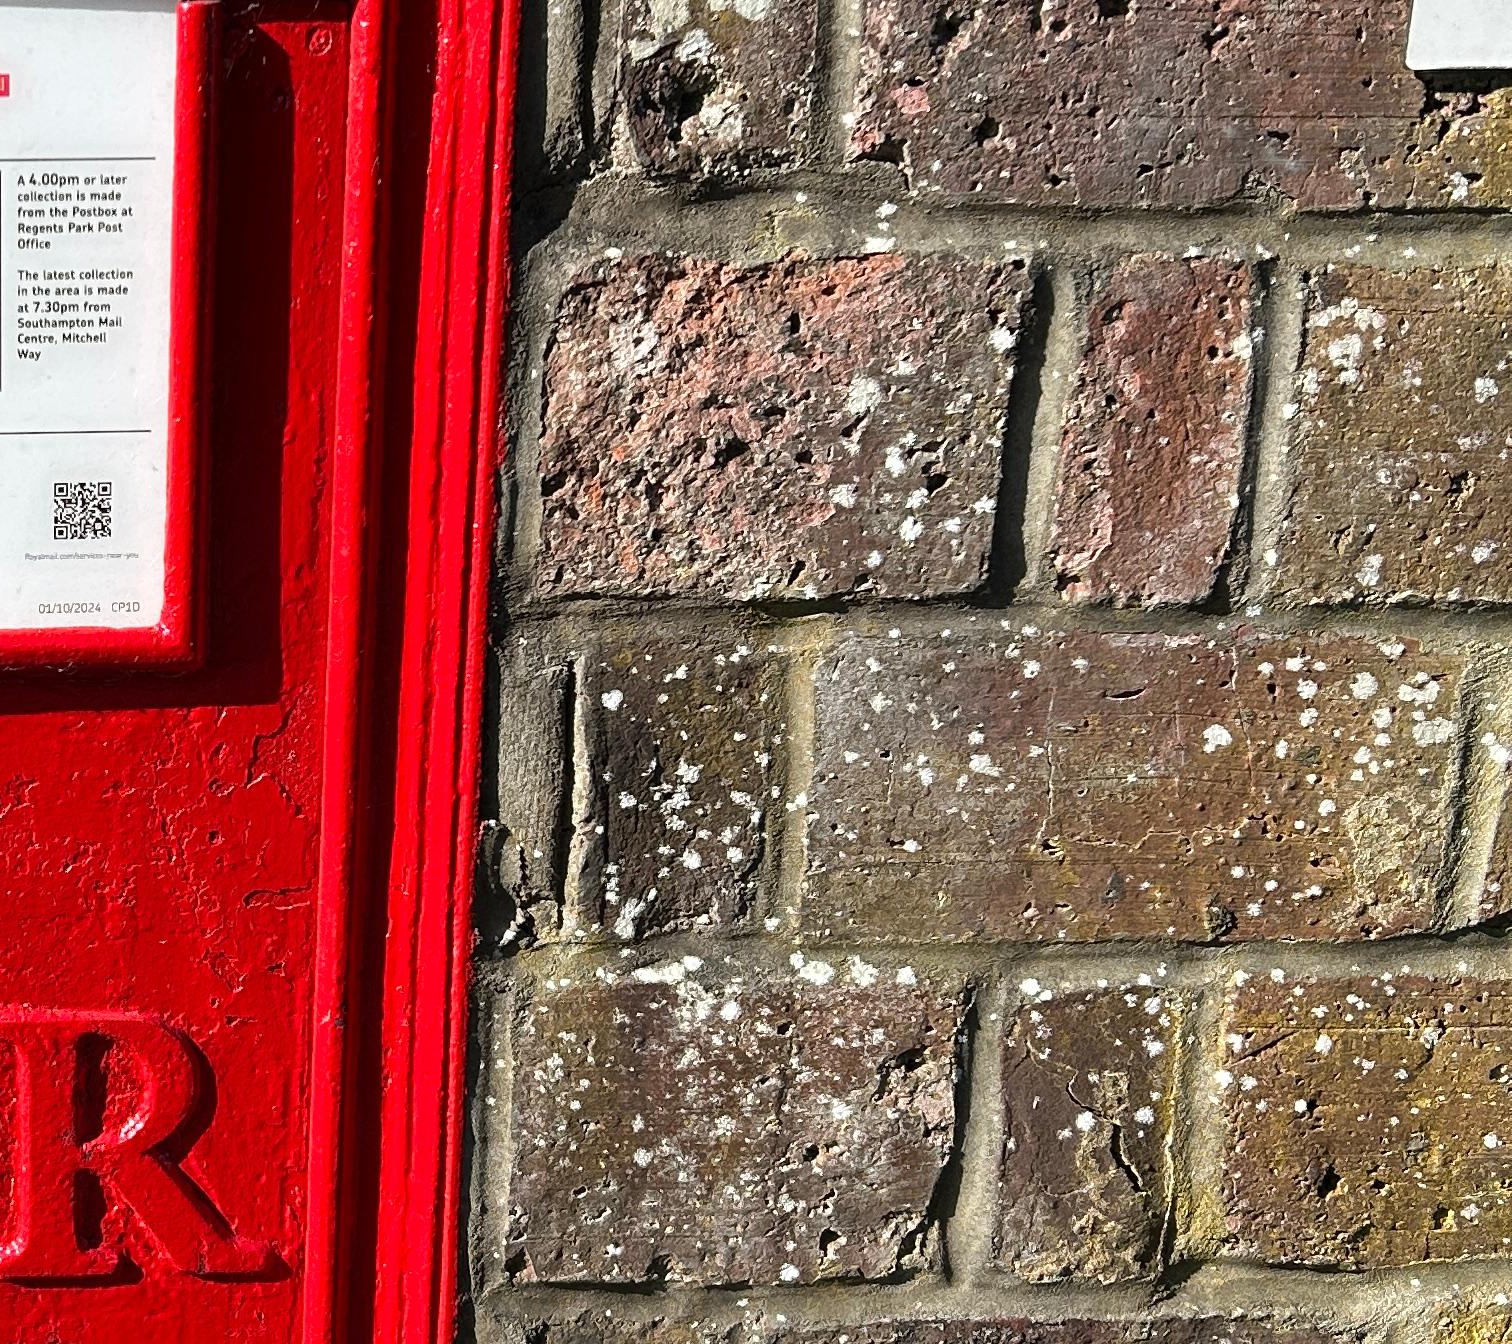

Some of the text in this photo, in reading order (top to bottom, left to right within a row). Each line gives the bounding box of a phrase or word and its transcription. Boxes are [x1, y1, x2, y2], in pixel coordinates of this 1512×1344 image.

[17, 173, 128, 188] A 4.00pm or later
[17, 190, 122, 202] collection is made
[17, 206, 133, 218] from the Postbox at
[17, 221, 123, 236] Regents Park Post
[17, 238, 51, 250] Office
[17, 268, 133, 281] The latest collection
[17, 284, 129, 296] in the area is made
[17, 301, 111, 315] at 7.30pm from
[17, 316, 123, 329] Southampton Mail
[17, 332, 107, 344] Centre, Mitchell
[17, 348, 41, 361] Way
[39, 601, 140, 614] 01/10/2024 CP1D
